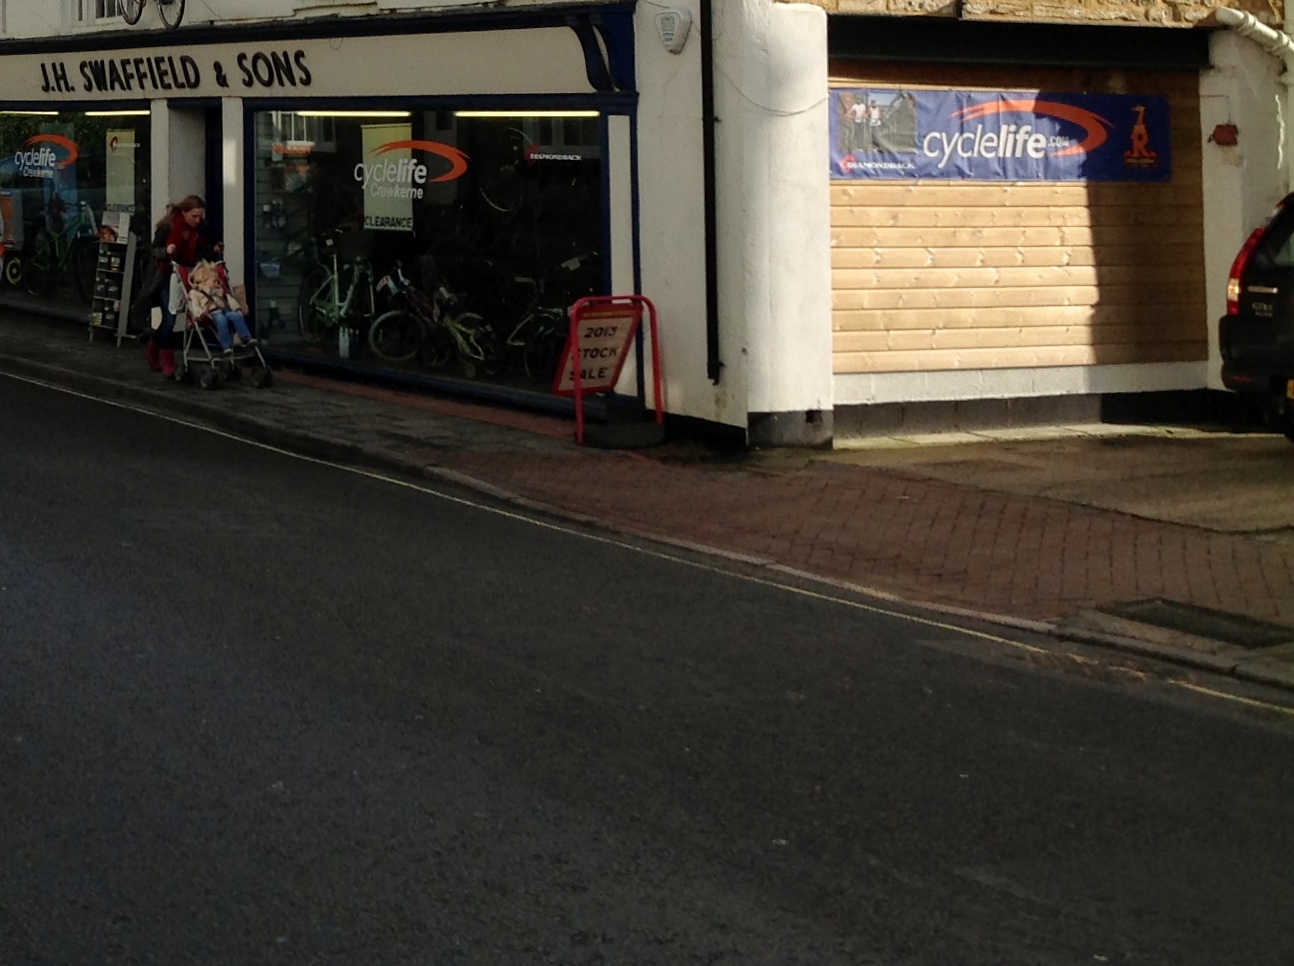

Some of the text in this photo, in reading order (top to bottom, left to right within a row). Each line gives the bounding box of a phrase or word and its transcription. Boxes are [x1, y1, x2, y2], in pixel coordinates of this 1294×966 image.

[40, 49, 312, 92] J.H. SWAFFIELD & SONS
[15, 147, 56, 171] cyclelife
[354, 159, 427, 189] cyclelife
[370, 183, 424, 199] Crewkerne
[365, 216, 412, 228] CLEARANCE
